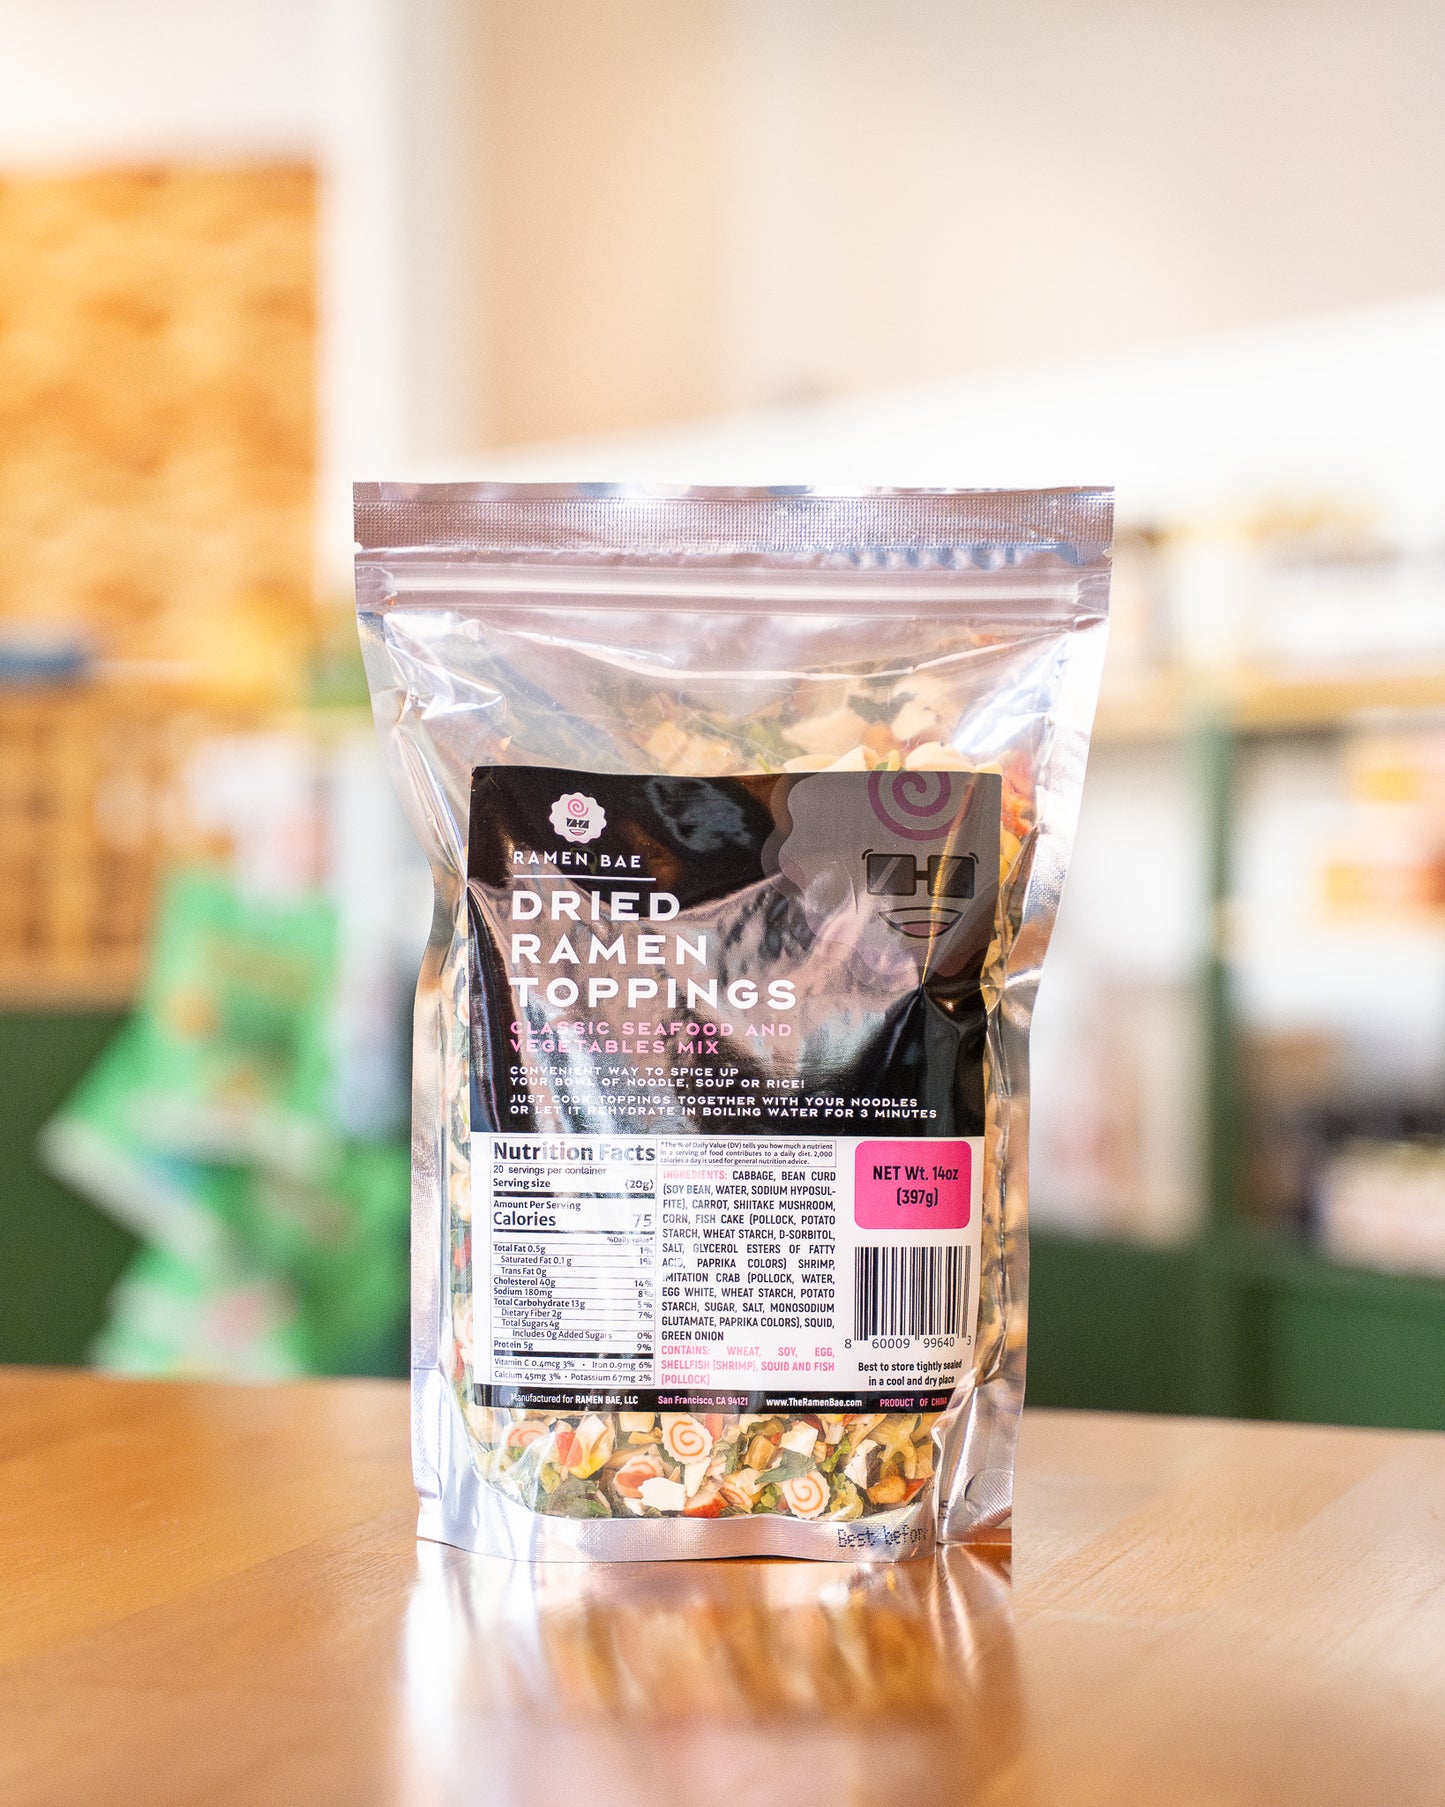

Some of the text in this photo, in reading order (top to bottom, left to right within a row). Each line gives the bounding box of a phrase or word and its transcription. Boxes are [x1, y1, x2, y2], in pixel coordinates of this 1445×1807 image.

[513, 851, 641, 868] RAMEN BAE
[512, 891, 680, 921] DRIED
[511, 934, 707, 965] RAMEN
[510, 978, 796, 1009] TOPPINGS
[510, 1022, 792, 1036] CLASSIC SEAFOOD AND
[510, 1040, 719, 1054] VEGETABLES MIX
[510, 1066, 602, 1076] CONVENIENT
[671, 1068, 712, 1076] SPICE
[720, 1068, 739, 1076] UP
[555, 1078, 595, 1086] BOWL
[602, 1079, 620, 1087] OF
[627, 1079, 689, 1088] NOODLE,
[696, 1079, 735, 1088] SOUP
[741, 1080, 759, 1088] OR
[767, 1080, 804, 1088] RICE!
[510, 1095, 918, 1107] JUST TOPPINGS TOGETHER WITH YOUR NOODLES
[510, 1106, 528, 1114] OR
[703, 1108, 761, 1116] BOILING
[769, 1108, 818, 1117] WATER
[825, 1109, 854, 1117] FOR
[875, 1110, 937, 1118] MINUTES
[494, 1142, 655, 1160] Nutrition Facts
[509, 1167, 545, 1176] servings
[663, 1170, 836, 1182] INGREDIENTS: CABBAGE, BEAN CURD
[873, 1166, 958, 1180] NET Wt. 14oz
[493, 1178, 653, 1191] Serving size (20g)
[716, 1186, 836, 1196] WATER, SODIUM HYPOSUL-
[897, 1188, 938, 1207] (397g)
[493, 1200, 544, 1209] Amount Per
[692, 1200, 836, 1212] CARROT, SHIITAKE MUSHROOM,
[494, 1211, 652, 1227] Calories 75
[721, 1215, 835, 1226] CAKE (POLLOCK, POTATO
[662, 1229, 835, 1241] STARCH, WHEAT STARCH, D-SORBITOL,
[494, 1244, 513, 1252] Total
[528, 1245, 545, 1254] 0.5g
[693, 1244, 835, 1254] GLYCEROL ESTERS OF FATTY
[501, 1256, 537, 1264] Saturated
[697, 1259, 835, 1270] PAPRIKA COLORS) SHRIMP,
[494, 1277, 555, 1288] Cholesterol 40g
[716, 1273, 740, 1282] CRAB
[748, 1273, 794, 1284] (POLLOCK,
[802, 1274, 835, 1284] WATER,
[525, 1288, 553, 1298] 180mg
[662, 1288, 835, 1299] EGG WHEAT STARCH, POTATO
[514, 1299, 569, 1308] Carbohydrate
[571, 1300, 585, 1309] 13g
[662, 1302, 835, 1313] STARCH, SUGAR, MONOSODIUM
[502, 1309, 528, 1318] Dietary
[522, 1320, 548, 1329] Sugars
[662, 1317, 835, 1329] GLUTAMATE, PAPRIKA SQUID,
[513, 1330, 544, 1338] Includes
[558, 1331, 583, 1339] Added
[586, 1332, 612, 1341] Sugars
[662, 1331, 723, 1341] GREEN ONION
[844, 1337, 955, 1349] 8 60009 99640
[662, 1346, 761, 1357] CONTAINS: WHEAT,
[495, 1358, 522, 1366] Vitamin
[532, 1359, 560, 1369] 0.4mcg
[610, 1362, 635, 1371] 0.9mg
[661, 1360, 811, 1371] SHELLFISH SQUID AND
[858, 1362, 942, 1372] Best to store tightly
[494, 1371, 610, 1381] Calcium Potassium
[886, 1376, 922, 1385] cool and
[511, 1393, 638, 1405] Manufactured for RAMEN BAE, LLC
[658, 1396, 725, 1406] San Francisco, CA
[766, 1397, 862, 1407] www.TheRamenBae.com
[880, 1398, 914, 1407] PRODUCT
[838, 1527, 875, 1547] Best
